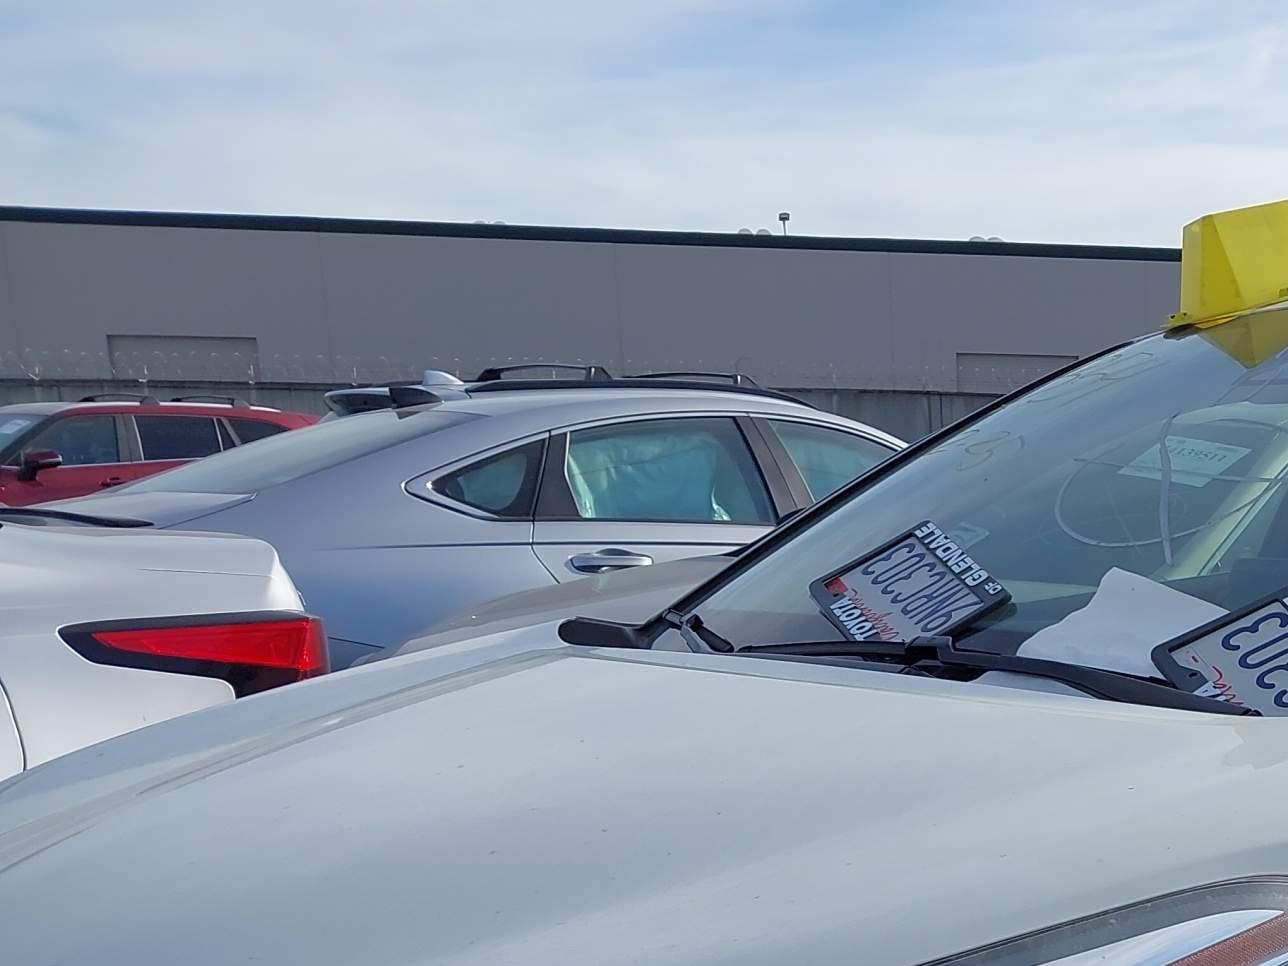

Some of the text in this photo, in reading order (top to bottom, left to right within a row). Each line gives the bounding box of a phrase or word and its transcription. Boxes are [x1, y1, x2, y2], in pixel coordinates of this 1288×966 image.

[861, 542, 985, 633] 9NRC303
[913, 522, 1002, 595] OF GLENDALE
[829, 595, 880, 641] TOYOTA
